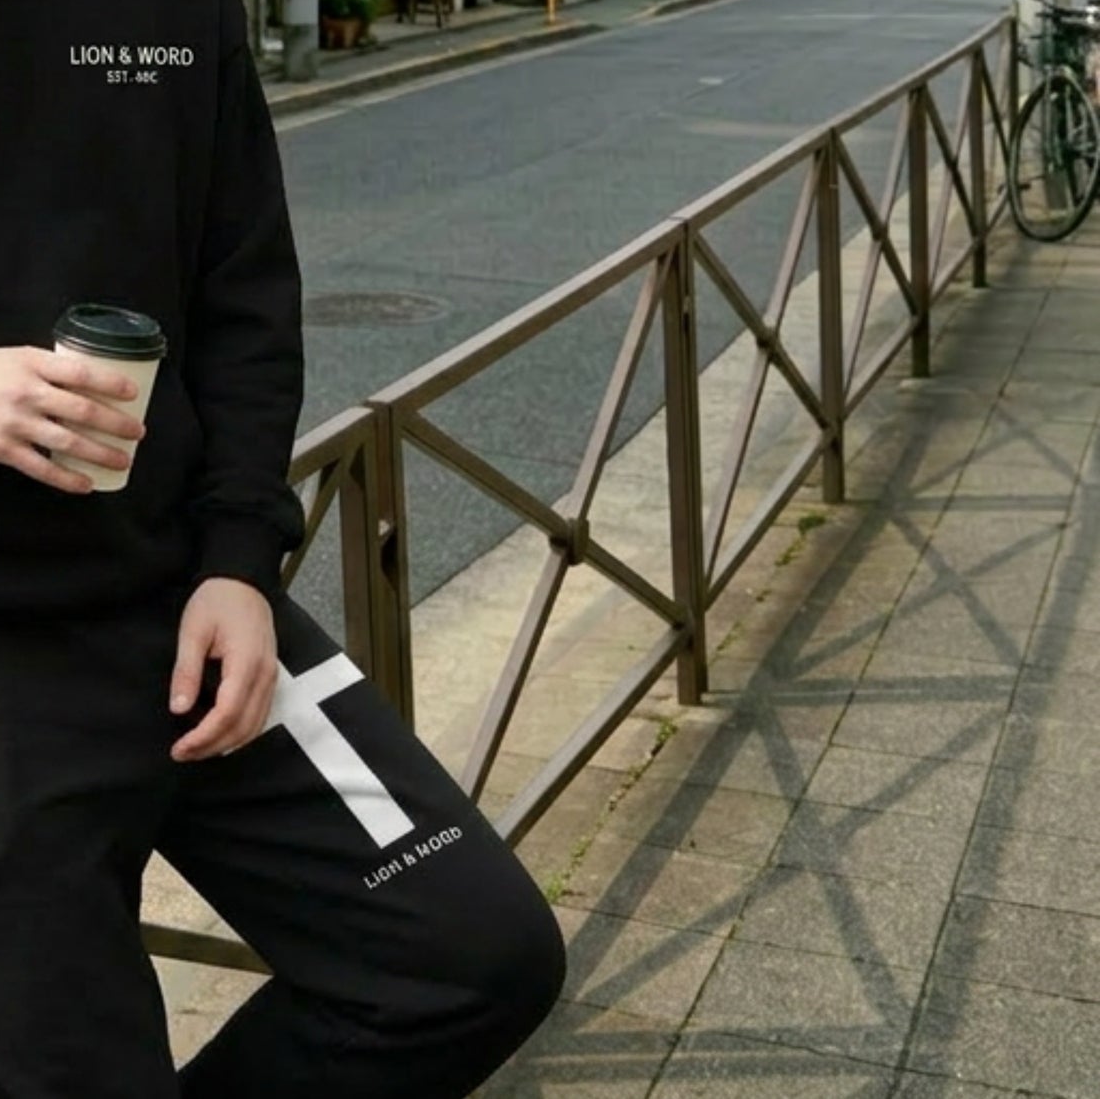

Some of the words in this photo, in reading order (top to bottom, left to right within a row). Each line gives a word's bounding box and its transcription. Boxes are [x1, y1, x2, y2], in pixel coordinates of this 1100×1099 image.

[70, 45, 114, 65] LION
[118, 46, 132, 65] &
[137, 46, 194, 66] WORD
